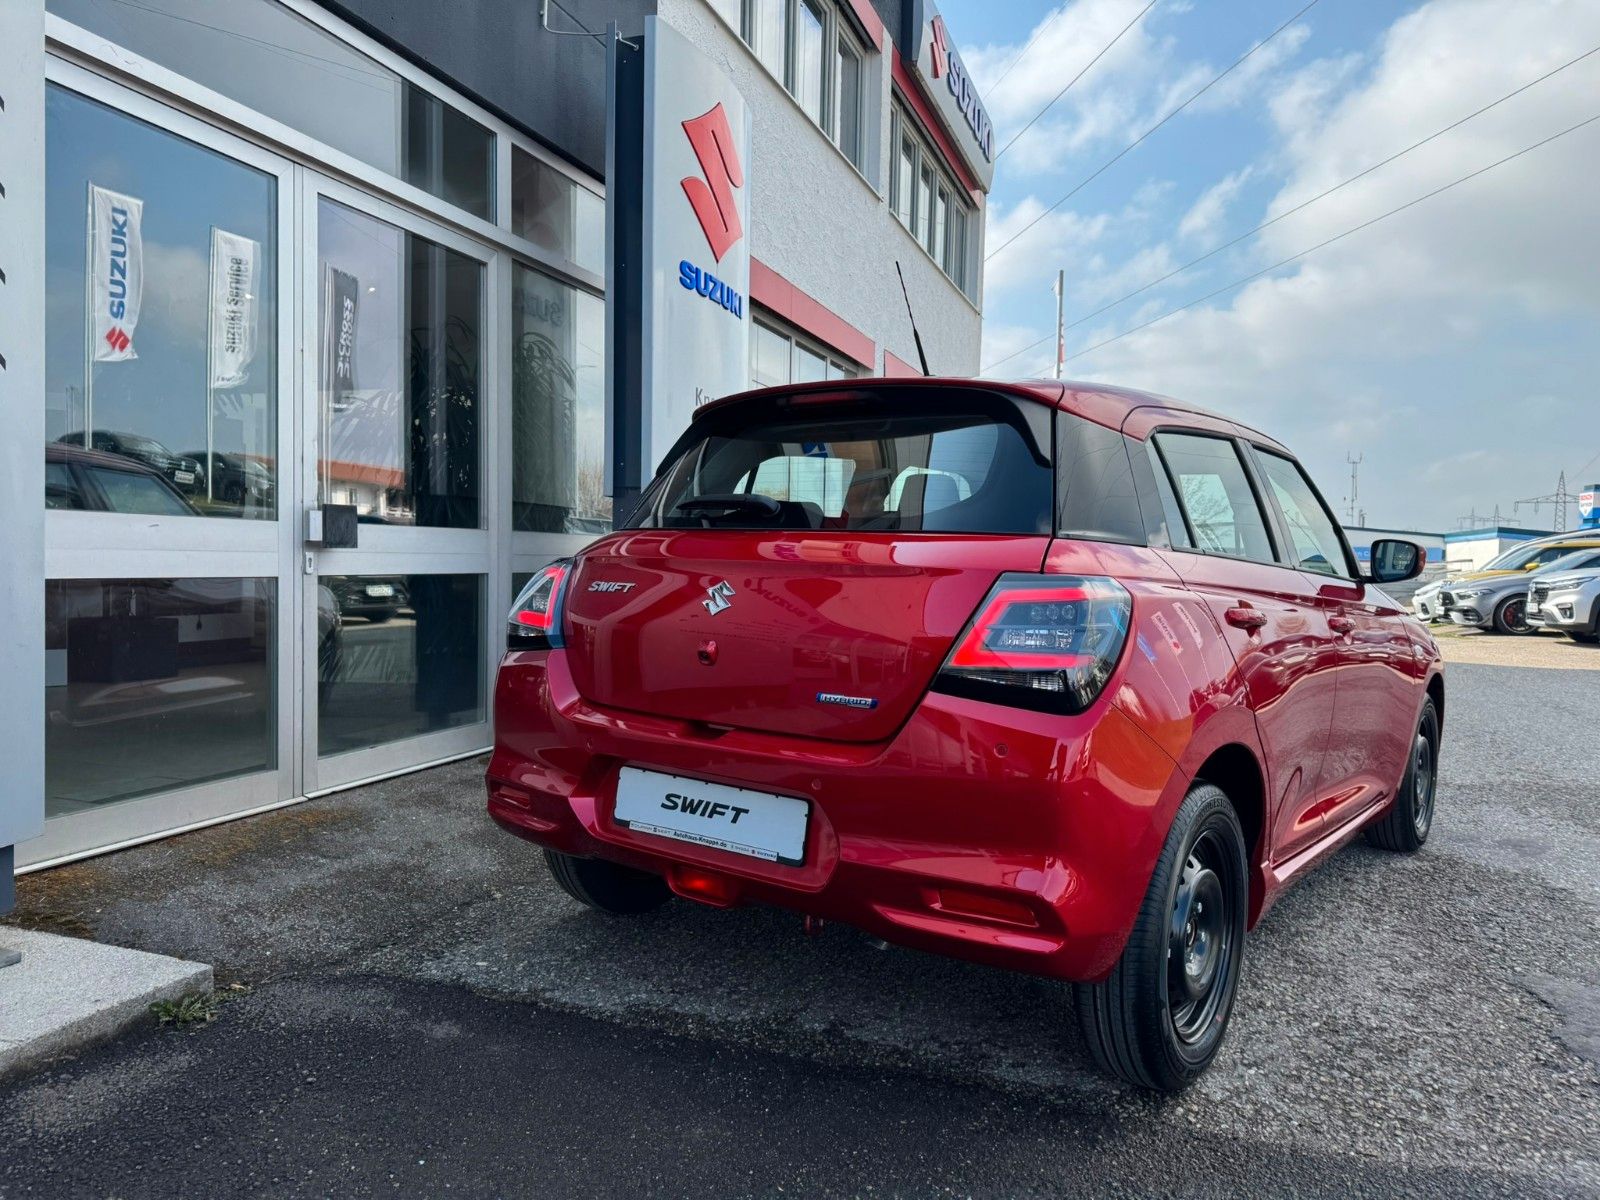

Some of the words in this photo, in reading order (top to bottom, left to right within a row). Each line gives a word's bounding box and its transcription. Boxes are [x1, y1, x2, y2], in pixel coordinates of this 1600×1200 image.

[947, 52, 991, 163] SUZUKI
[109, 206, 128, 320] SUZUKI
[679, 259, 742, 320] SUZUKI
[588, 581, 636, 593] SWIFT
[824, 695, 867, 706] HYBRID
[660, 793, 750, 824] SWIFT
